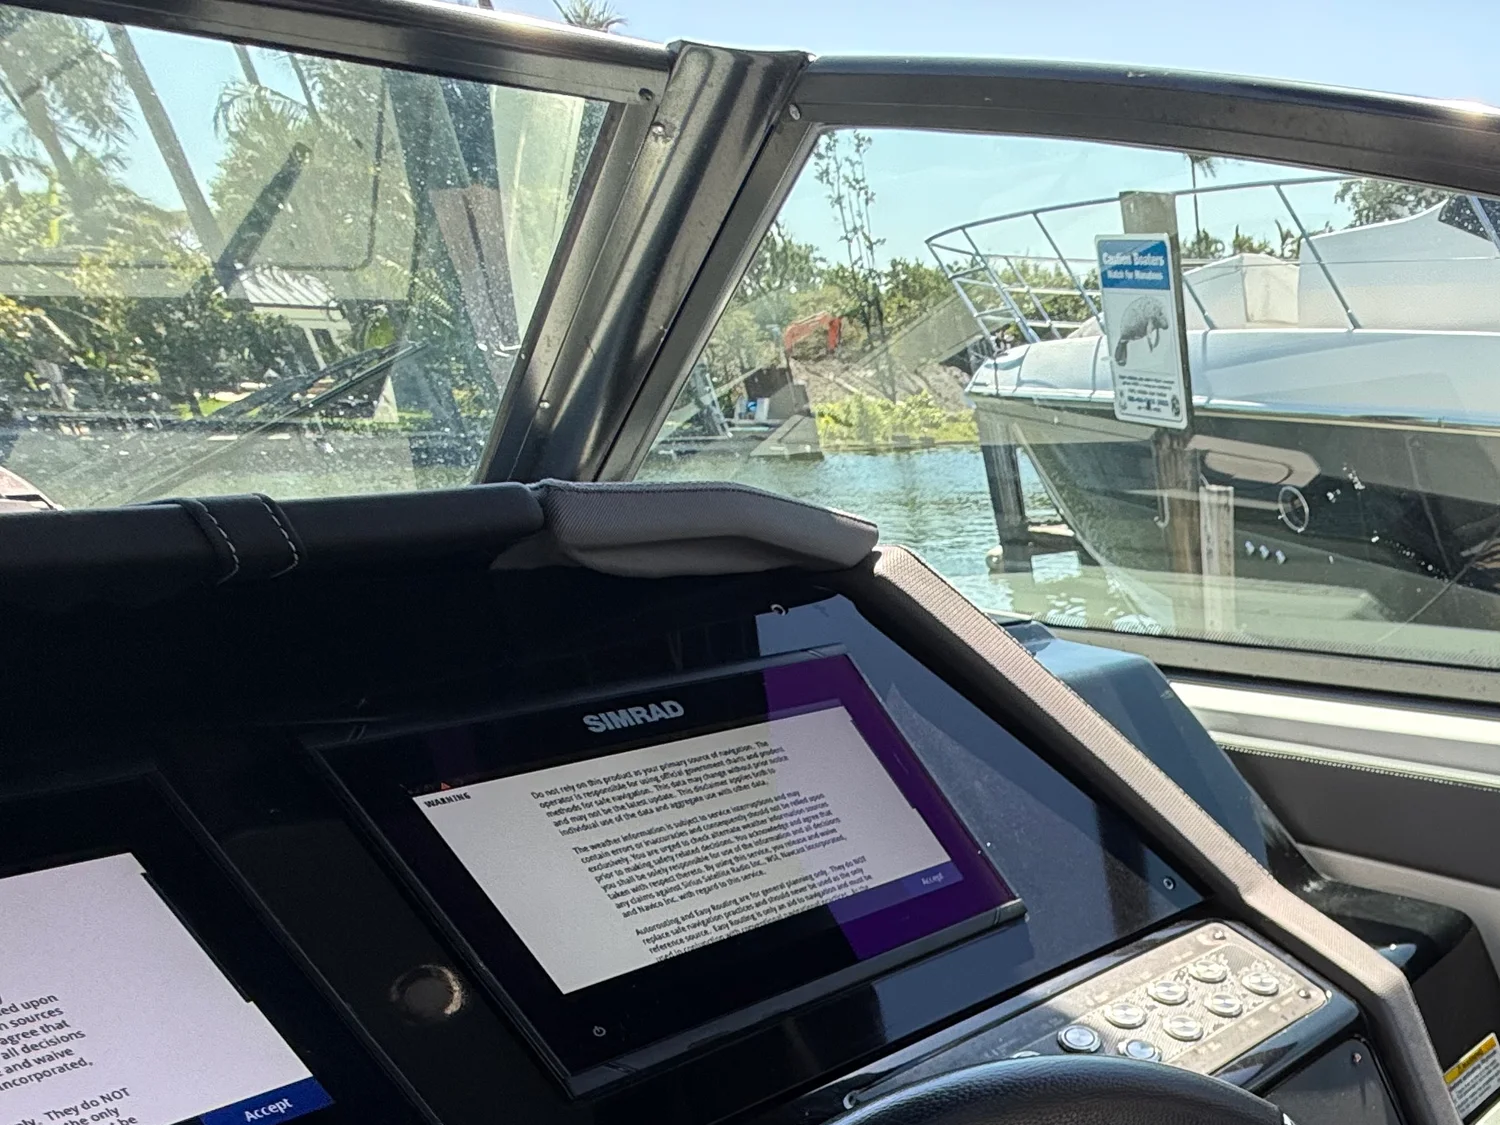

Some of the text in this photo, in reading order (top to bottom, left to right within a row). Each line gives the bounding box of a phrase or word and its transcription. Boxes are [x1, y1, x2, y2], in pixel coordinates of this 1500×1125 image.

[583, 700, 684, 732] SIMRAD
[540, 795, 573, 809] operator
[583, 783, 628, 798] responsible
[627, 780, 638, 788] for
[545, 787, 561, 796] not
[560, 784, 575, 793] rely
[588, 778, 603, 786] this
[603, 771, 634, 785] product
[424, 792, 471, 808] WARNING
[546, 804, 582, 817] methods
[582, 801, 593, 809] for
[595, 797, 612, 806] safe
[612, 788, 654, 802] navigation.
[554, 816, 570, 826] and
[570, 814, 587, 823] may
[587, 810, 603, 818] not
[613, 804, 627, 812] the
[625, 798, 649, 809] latest
[559, 820, 600, 836] individual
[599, 818, 615, 826] use
[615, 814, 623, 822] of
[624, 812, 637, 820] the
[638, 808, 655, 816] data
[573, 846, 590, 854] The
[589, 837, 620, 850] weather
[620, 826, 667, 842] information
[582, 851, 612, 863] contain
[612, 845, 635, 855] errors
[643, 830, 689, 846] inaccuracies
[588, 856, 632, 872] exclusively.
[630, 852, 647, 860] You
[660, 841, 682, 852] urged
[594, 871, 613, 883] prior
[624, 861, 654, 873] making
[653, 855, 675, 865] safety
[675, 846, 701, 859] related
[601, 882, 617, 892] you
[617, 875, 636, 886] shall
[634, 873, 647, 881] be
[647, 866, 668, 877] solely
[668, 855, 710, 871] responsible
[608, 889, 631, 899] taken
[631, 883, 649, 893] with
[648, 875, 676, 888] respect
[676, 868, 705, 879] thereto.
[616, 900, 629, 908] any
[631, 892, 655, 904] claims
[656, 884, 683, 897] against
[682, 878, 703, 888] Sirius
[622, 907, 638, 917] and
[637, 901, 664, 913] Navico
[663, 897, 679, 905] Inc.
[678, 890, 696, 900] with
[695, 882, 720, 895] regard
[636, 917, 682, 935] Autorouting
[681, 911, 696, 921] and
[694, 907, 711, 916] Easy
[710, 898, 740, 911] Routing
[642, 931, 671, 944] replace
[671, 925, 687, 935] safe
[686, 914, 724, 930] navigation
[649, 937, 685, 953] reference
[685, 929, 713, 941] source.
[713, 922, 729, 932] Easy
[20, 995, 59, 1010] upon
[0, 1020, 71, 1045] agree that
[9, 1008, 64, 1028] sources
[1, 1031, 86, 1060] all decisions
[4, 1048, 75, 1074] and waive
[44, 1105, 80, 1121] They
[80, 1099, 100, 1110] do
[100, 1088, 130, 1104] NOT
[90, 1108, 120, 1122] only
[245, 1098, 293, 1122] Accept
